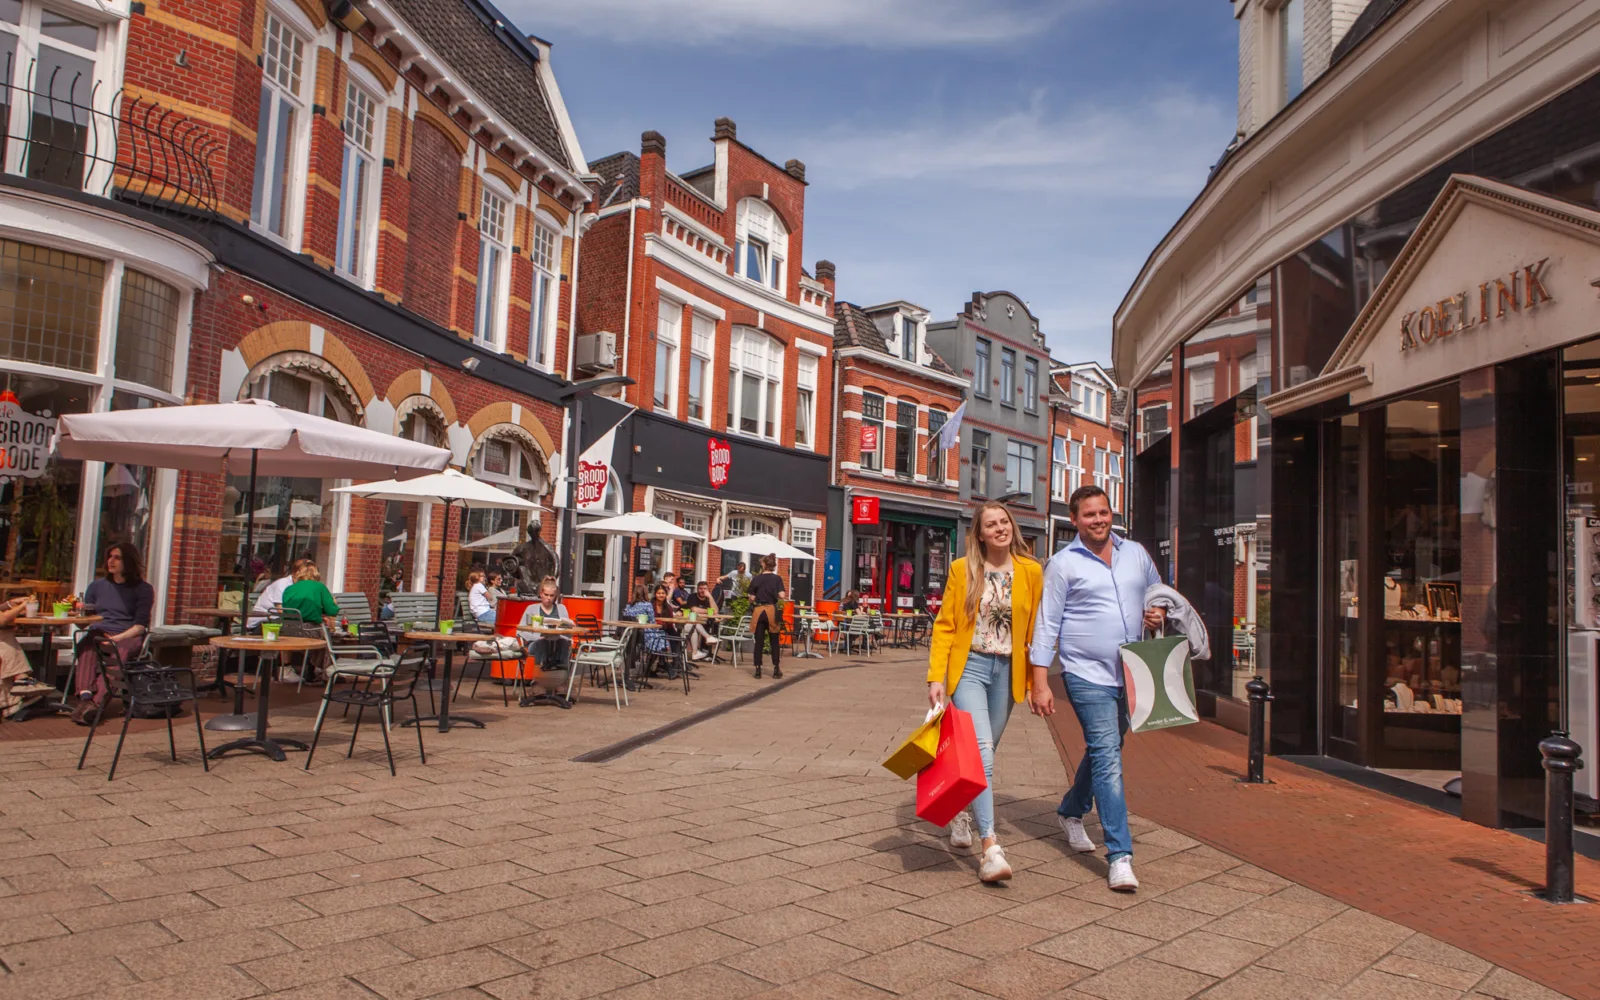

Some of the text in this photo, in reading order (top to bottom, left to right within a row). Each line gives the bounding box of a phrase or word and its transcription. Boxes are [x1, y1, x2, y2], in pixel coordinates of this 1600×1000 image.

[1400, 257, 1552, 352] KOELINK
[0, 404, 14, 418] de
[0, 420, 55, 448] BROOD
[0, 445, 41, 471] BODE
[711, 448, 730, 466] BROOD
[578, 462, 586, 471] de
[711, 464, 727, 482] BODE
[578, 469, 605, 486] BROOD
[578, 484, 600, 501] BODE
